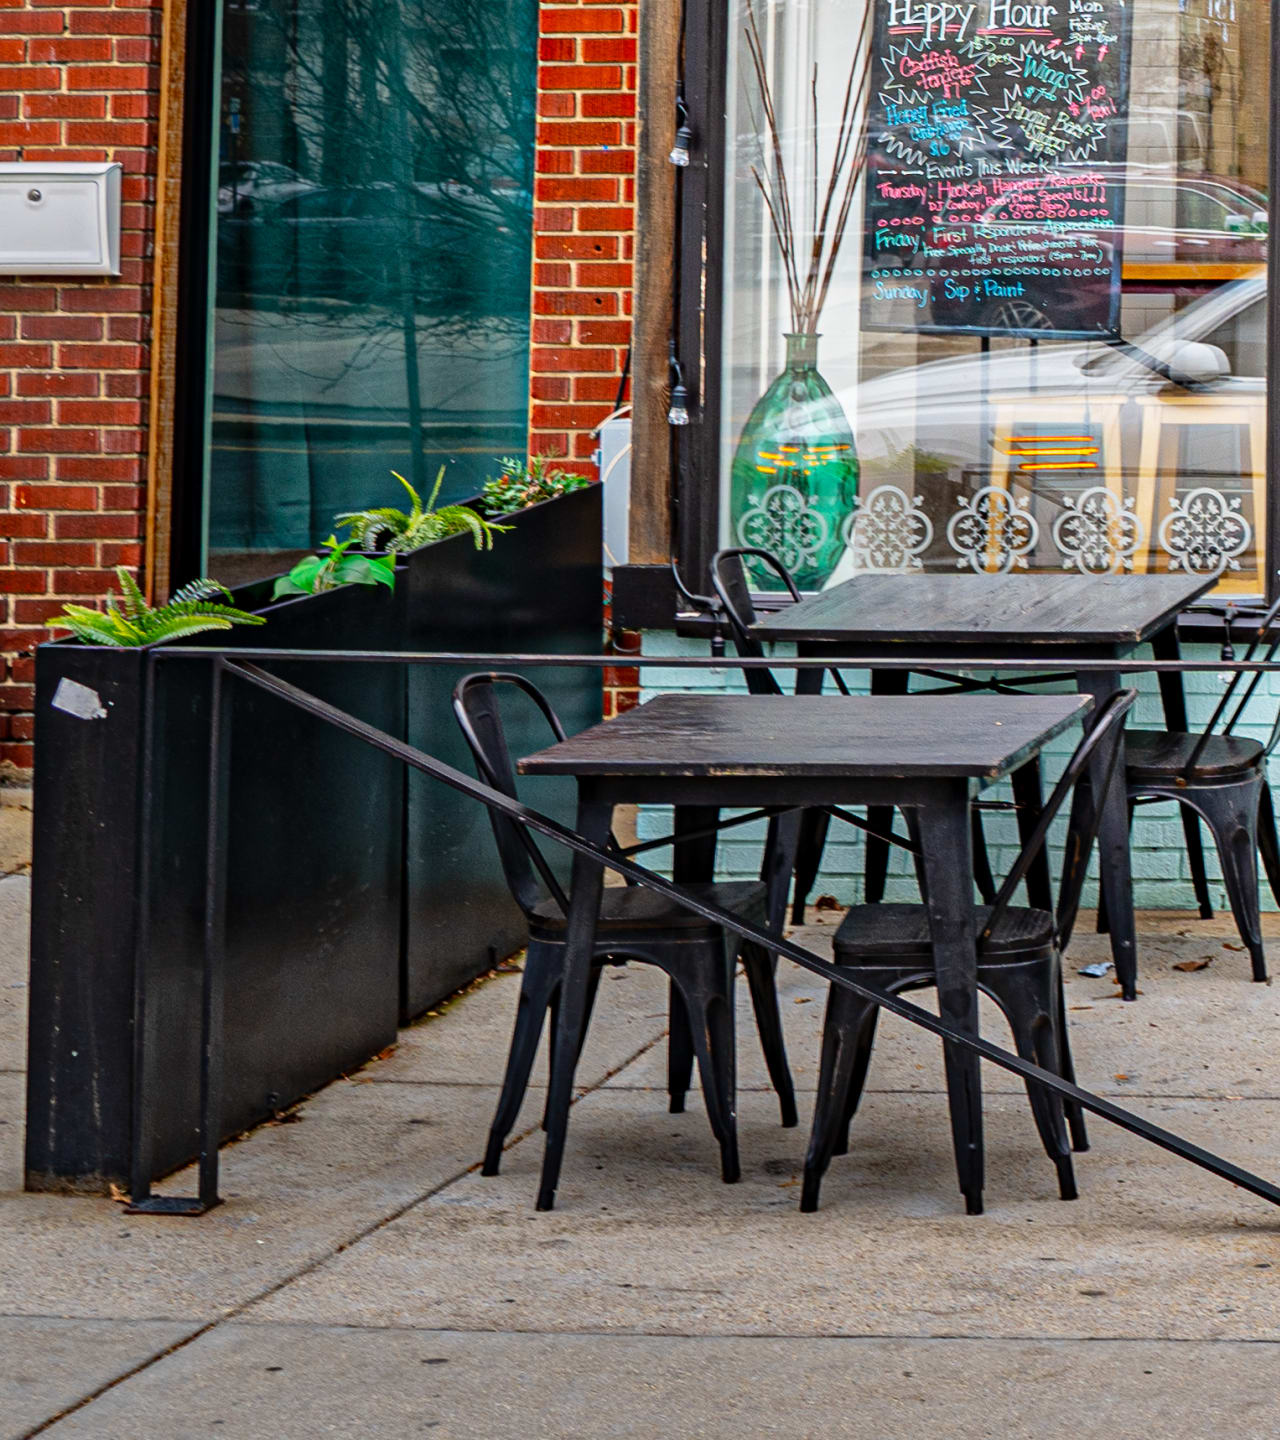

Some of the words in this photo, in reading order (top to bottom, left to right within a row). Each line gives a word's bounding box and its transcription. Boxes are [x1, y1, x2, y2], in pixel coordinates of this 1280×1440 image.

[1022, 54, 1077, 90] Wings
[925, 160, 973, 179] Events
[974, 157, 1002, 177] This
[937, 180, 989, 199] Hookah
[944, 278, 970, 302] Sip
[984, 278, 1026, 297] Paint
